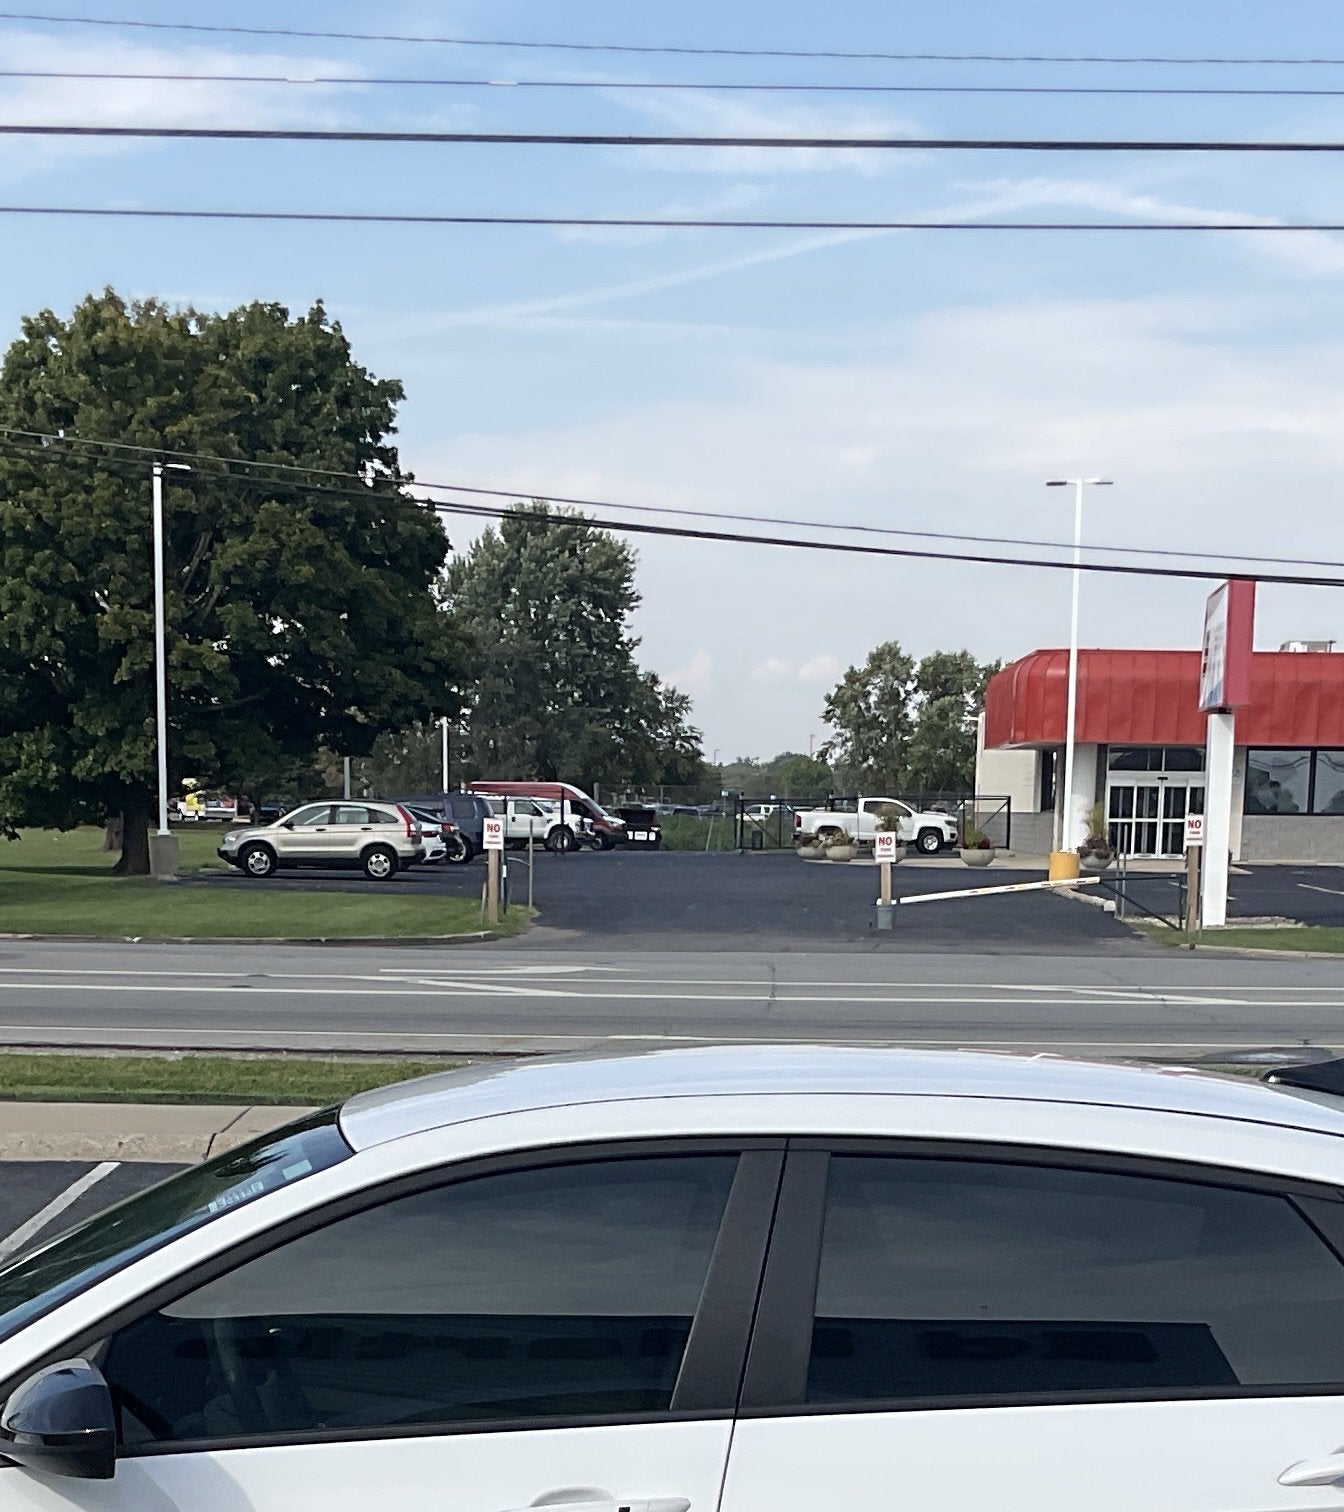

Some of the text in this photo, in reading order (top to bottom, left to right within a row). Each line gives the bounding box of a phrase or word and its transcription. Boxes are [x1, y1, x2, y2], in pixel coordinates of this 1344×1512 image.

[486, 823, 501, 833] NO
[1187, 819, 1202, 829] NO
[878, 836, 893, 846] NO
